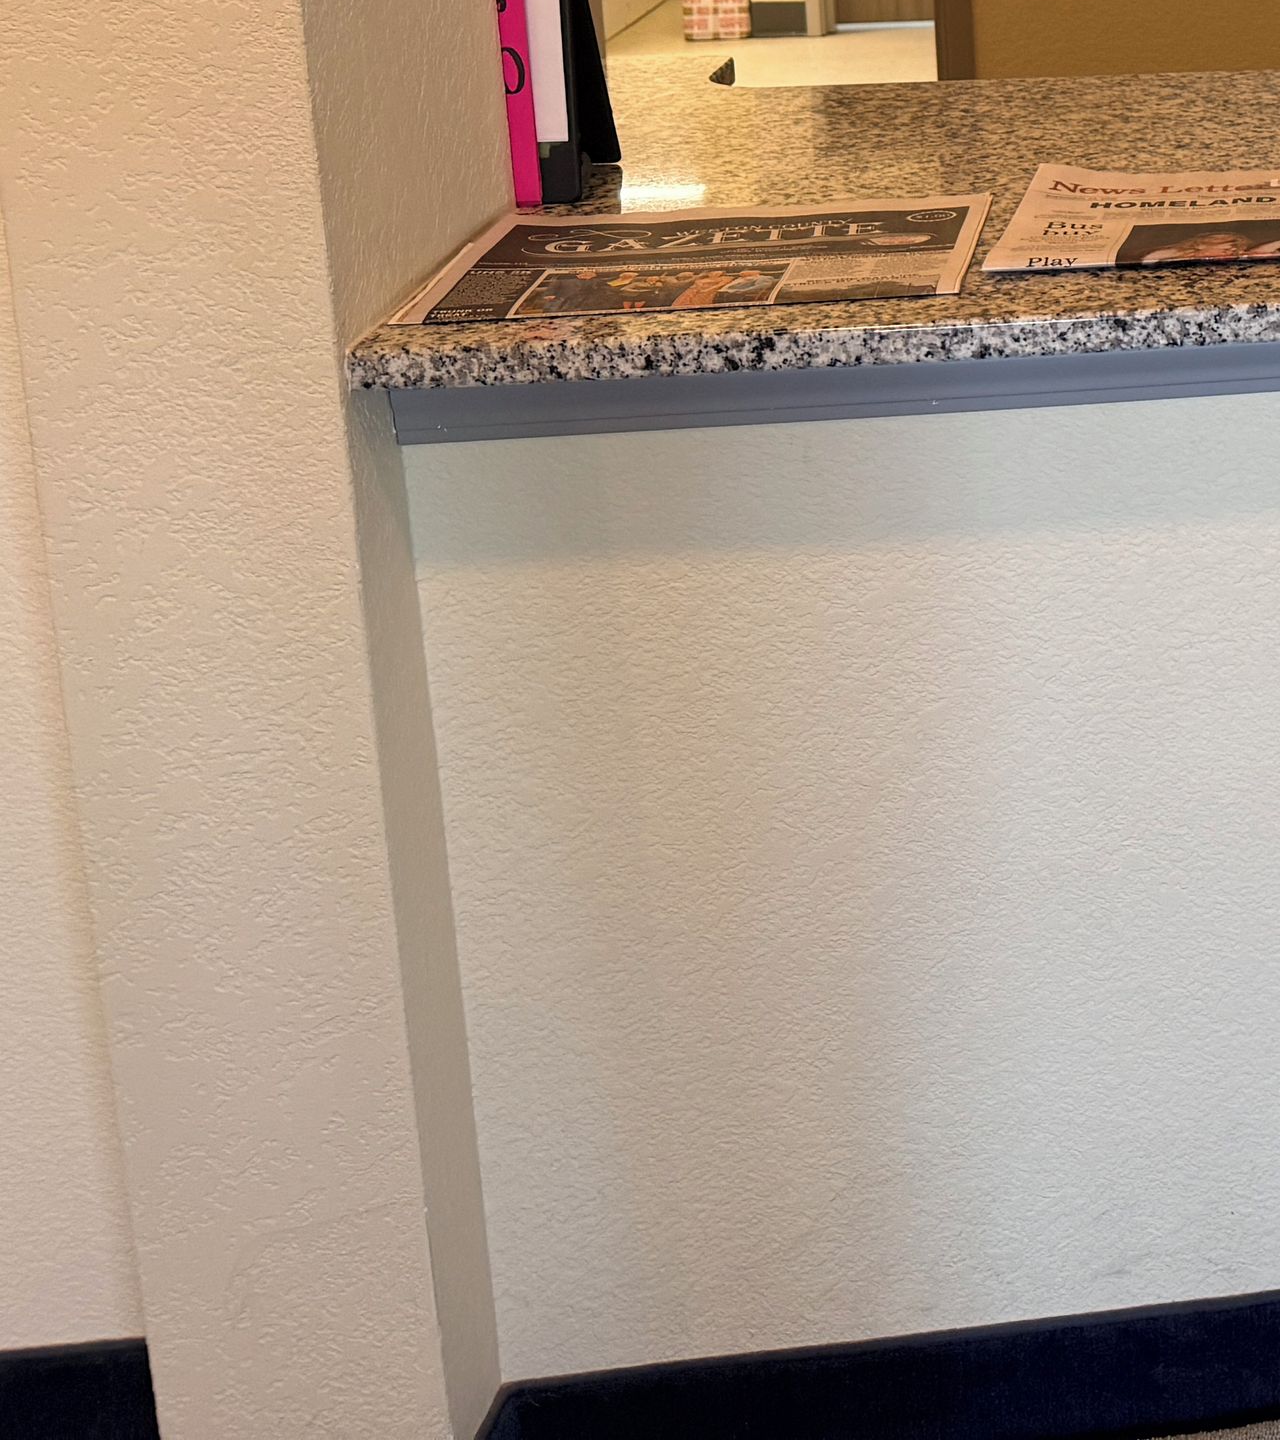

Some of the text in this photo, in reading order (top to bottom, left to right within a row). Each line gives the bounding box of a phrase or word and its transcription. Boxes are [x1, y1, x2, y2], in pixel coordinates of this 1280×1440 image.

[1048, 180, 1146, 195] News
[1090, 196, 1277, 209] HOMELAND
[1046, 221, 1103, 230] Bus
[545, 221, 884, 252] GAZETTE
[1026, 257, 1078, 268] Play
